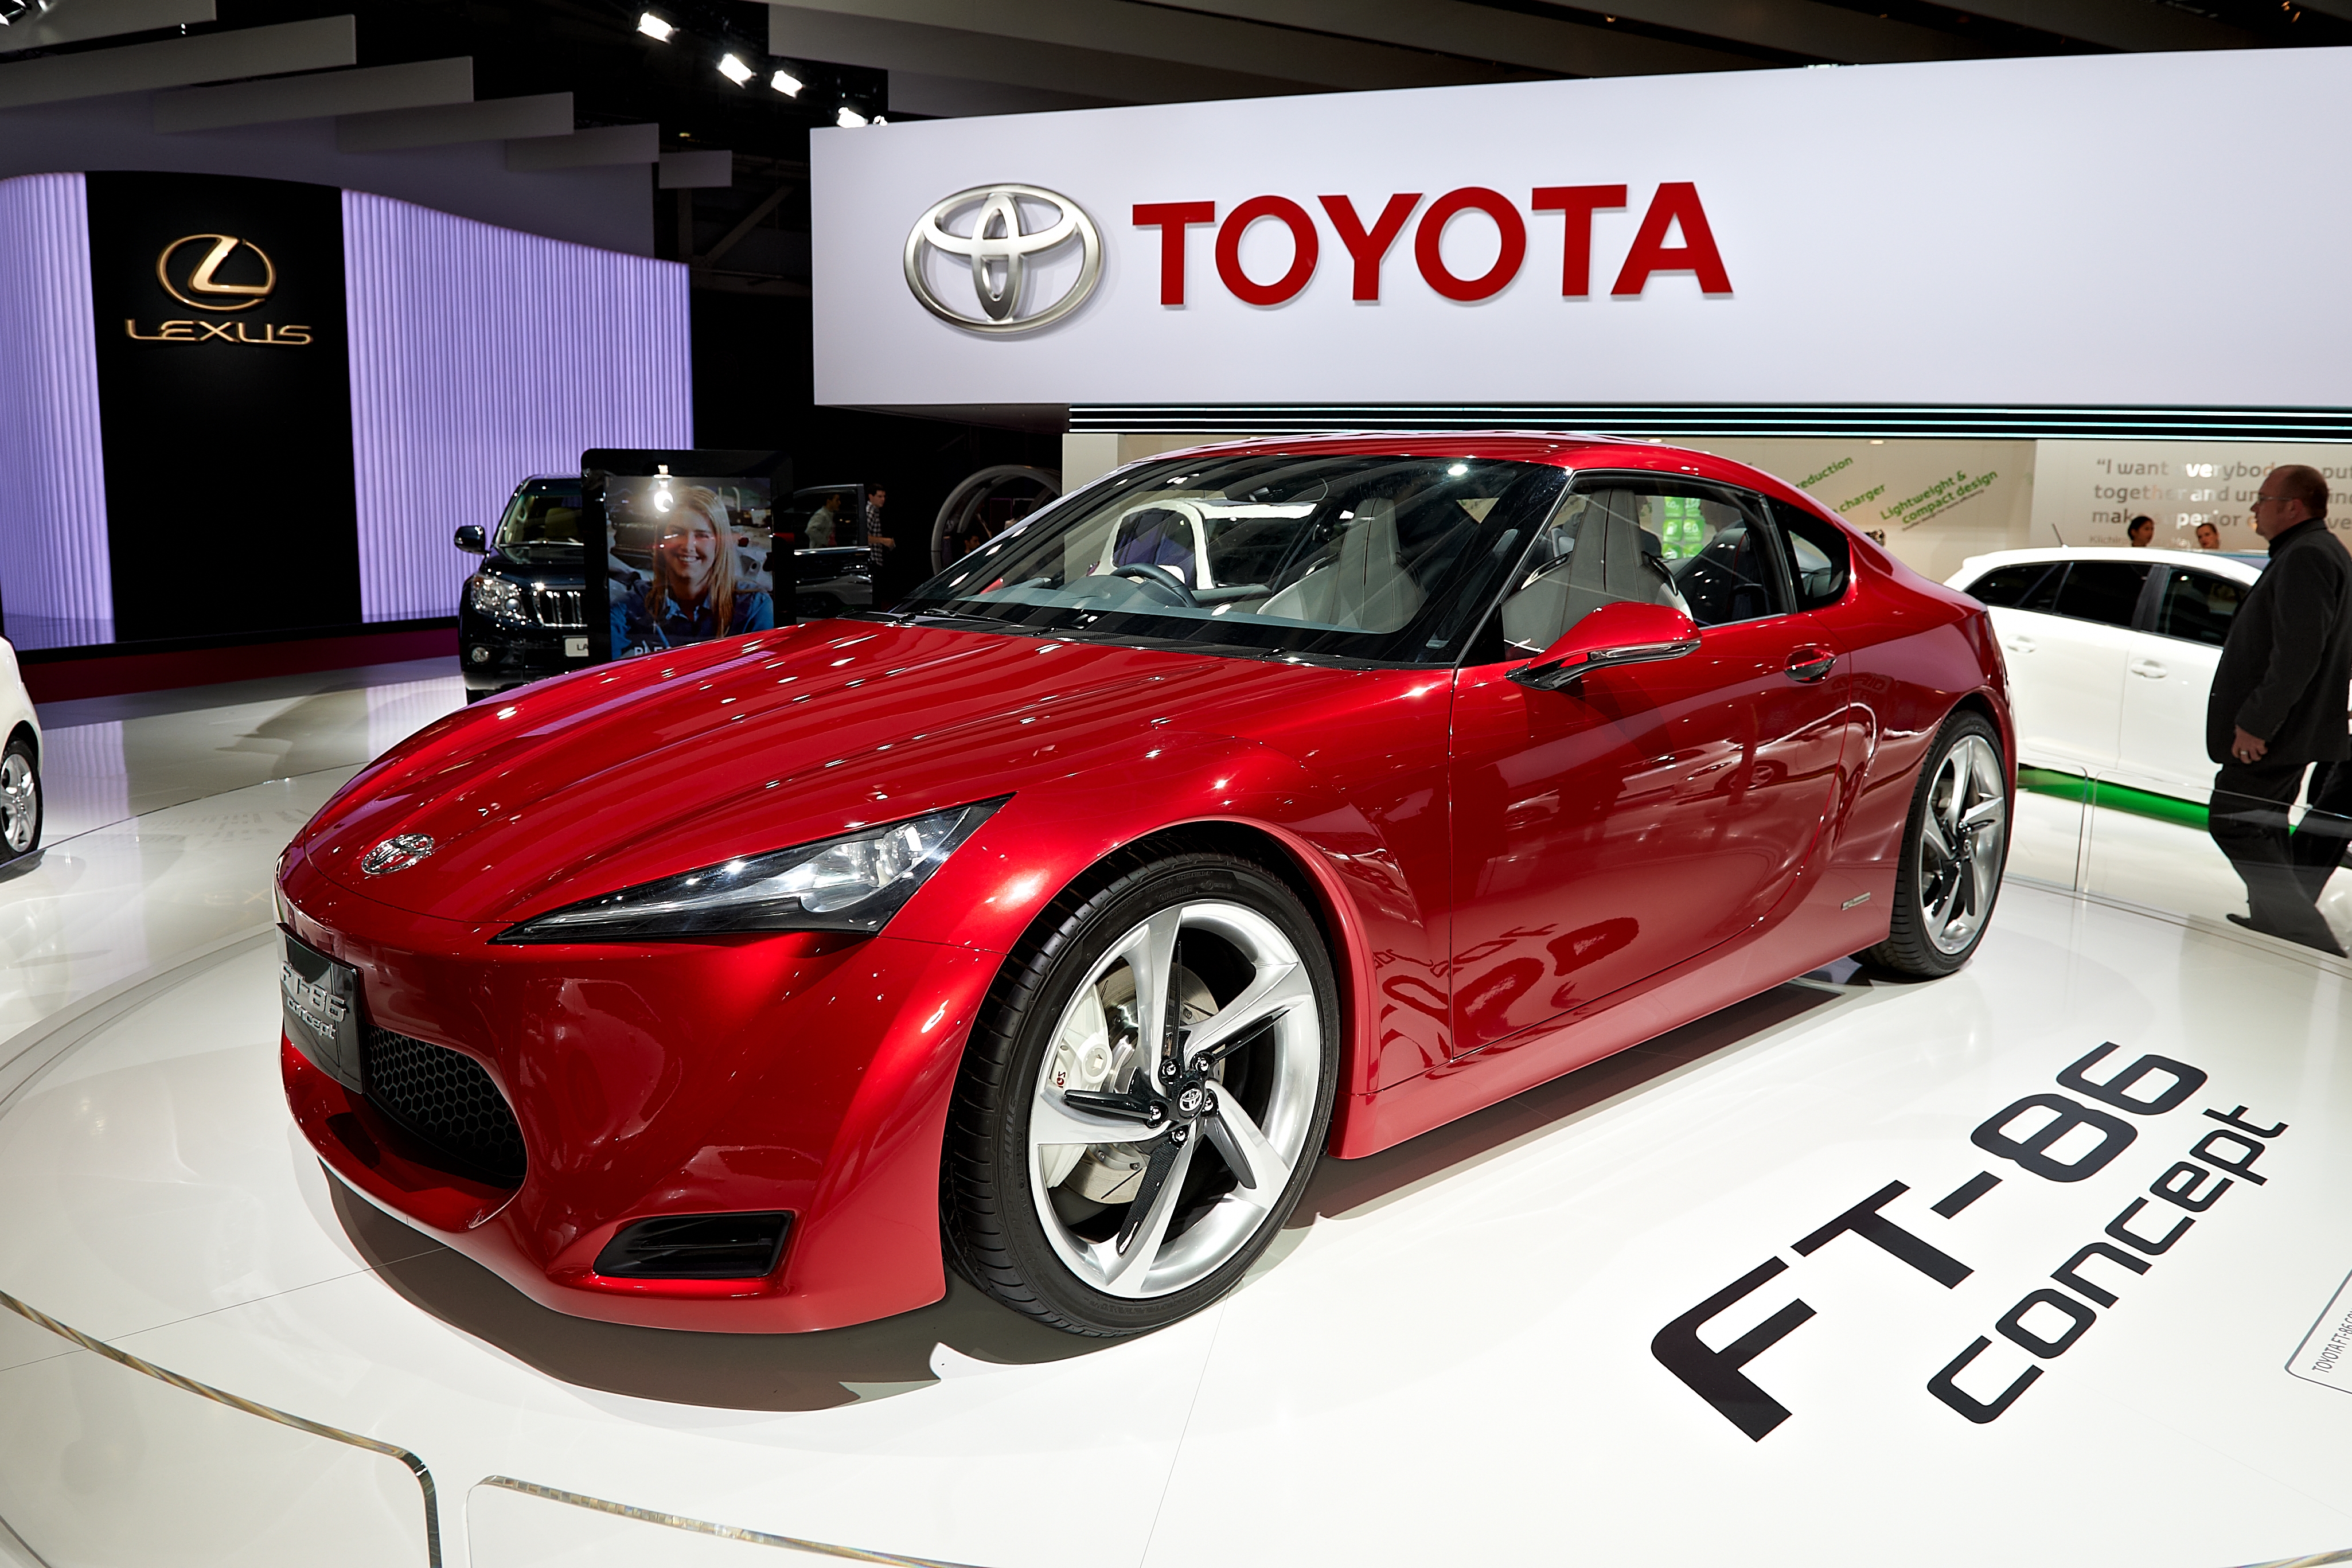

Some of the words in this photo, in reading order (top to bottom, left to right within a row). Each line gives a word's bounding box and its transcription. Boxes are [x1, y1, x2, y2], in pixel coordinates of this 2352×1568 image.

[1133, 183, 1733, 306] TOYOTA
[125, 319, 313, 345] LEXUS
[2117, 461, 2169, 475] want
[1839, 485, 1885, 512] charger
[1880, 477, 1955, 520] Lightweight
[1956, 470, 1967, 481] &
[1902, 493, 1955, 524] compact
[1956, 471, 1998, 496] design
[2094, 485, 2187, 504] together
[2190, 486, 2229, 502] and
[280, 960, 346, 1023] FT-86
[287, 996, 336, 1040] concept
[1651, 1042, 2207, 1442] FT-86
[1927, 1106, 2288, 1423] concept
[2311, 1344, 2345, 1373] TOYOTA
